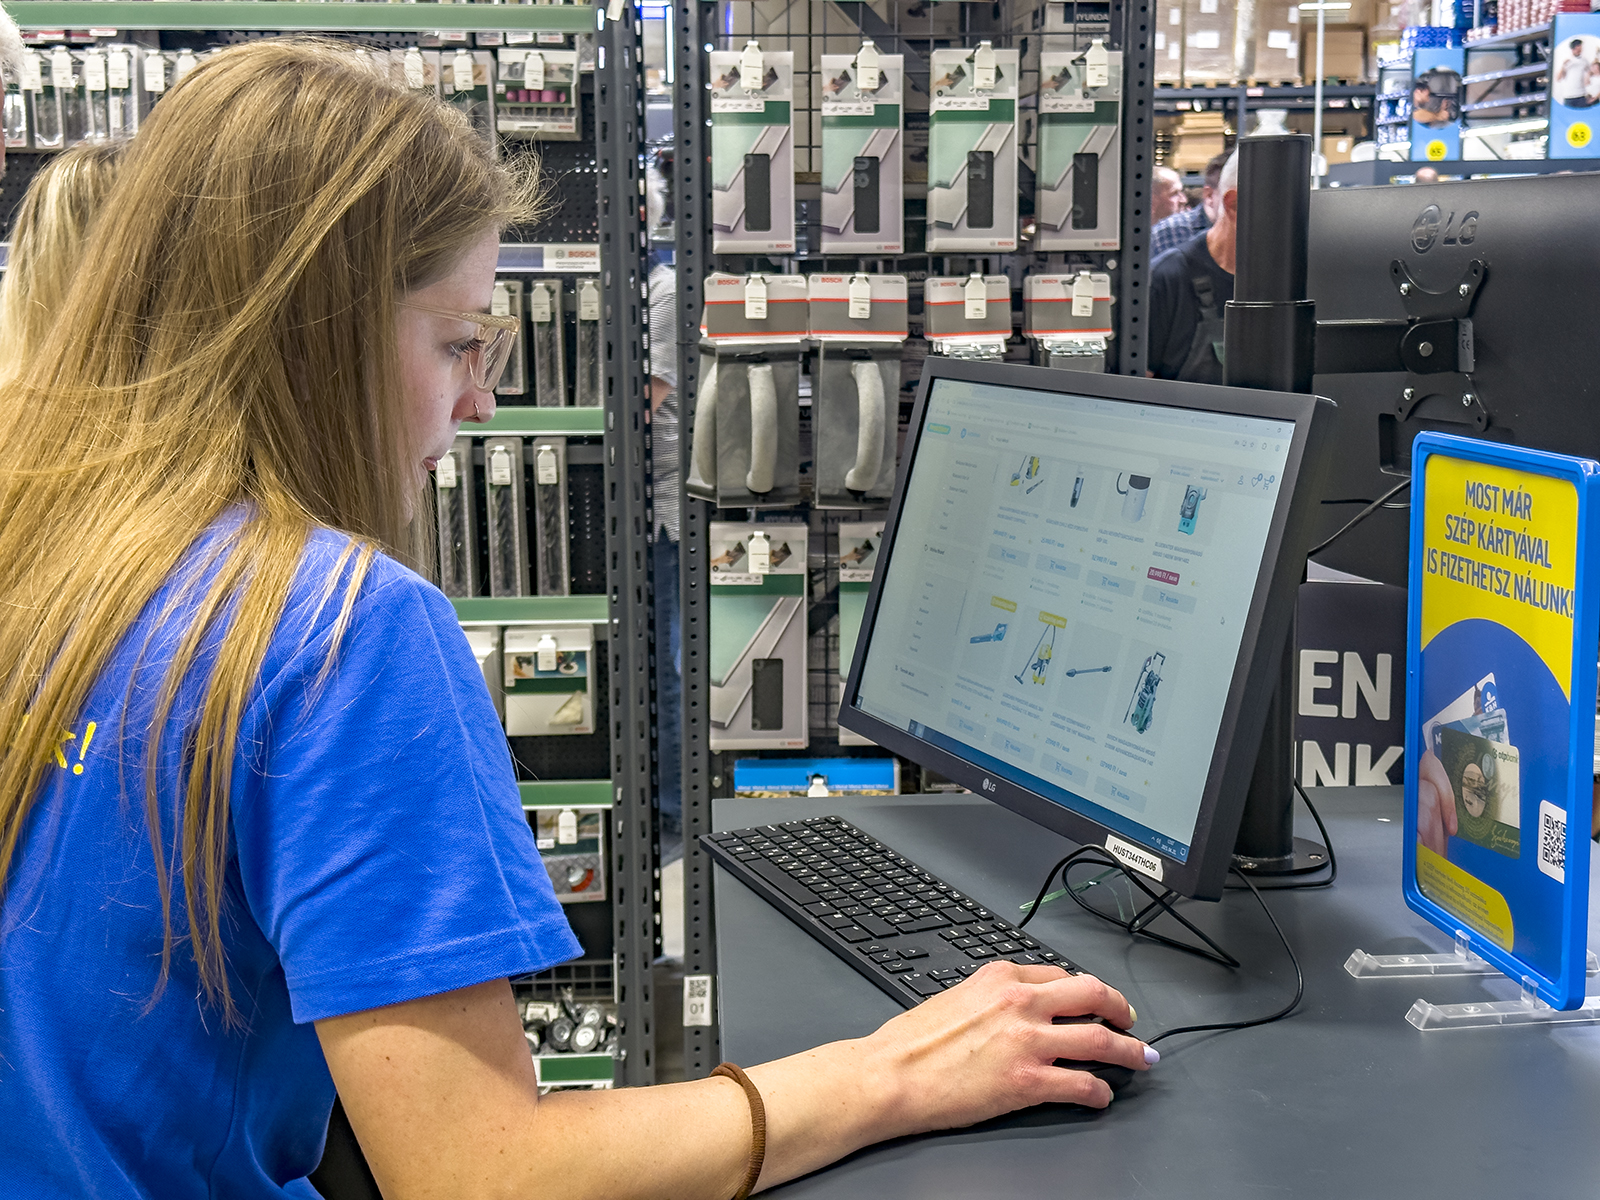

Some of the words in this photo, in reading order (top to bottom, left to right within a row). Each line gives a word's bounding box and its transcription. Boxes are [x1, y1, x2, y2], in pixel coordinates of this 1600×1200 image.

[1465, 480, 1500, 513] MOST
[1502, 484, 1532, 521] MÁR
[1445, 512, 1475, 546] SZÉP
[1478, 519, 1552, 569] KÁRTYÁVAL
[1427, 547, 1438, 575] IS
[1440, 551, 1511, 598] FIZETHETSZ
[1514, 570, 1575, 619] NÁLUNK!
[1298, 649, 1392, 721] EN
[1294, 740, 1405, 787] NK
[988, 782, 997, 793] LG
[1112, 844, 1157, 872] HUST344THC06
[690, 1003, 705, 1015] 01
